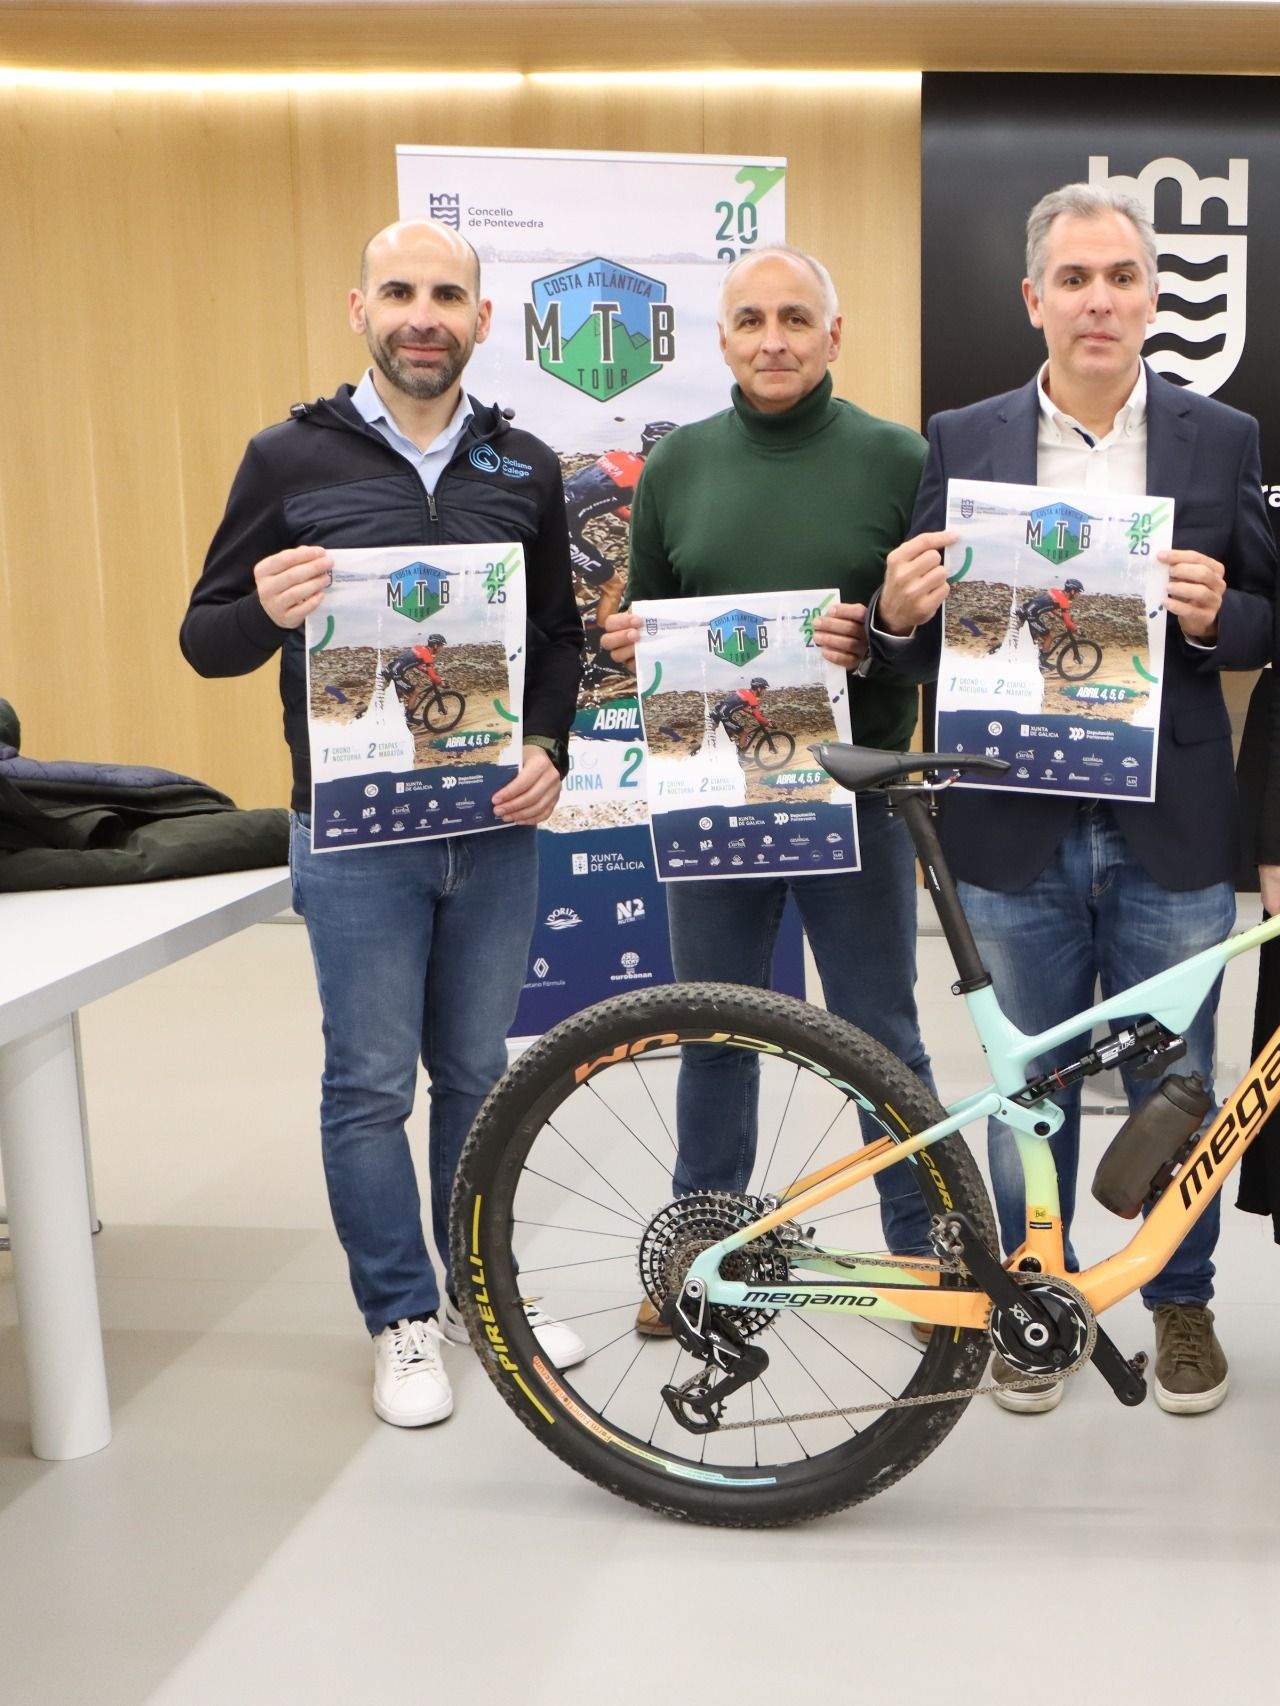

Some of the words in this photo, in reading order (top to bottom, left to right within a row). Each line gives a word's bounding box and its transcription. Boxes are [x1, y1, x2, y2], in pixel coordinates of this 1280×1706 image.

[468, 206, 513, 216] Concello
[468, 218, 481, 227] de
[484, 218, 544, 230] Pontevedra
[715, 201, 758, 244] 20
[543, 276, 582, 298] COSTA
[586, 268, 653, 298] ATLÁNTICA
[523, 303, 676, 363] MTB
[577, 368, 629, 391] TOUR
[502, 456, 532, 470] Ciclismo
[1130, 512, 1151, 533] 20
[1129, 535, 1150, 556] 25
[486, 563, 506, 582] 20
[488, 585, 506, 604] 25
[805, 629, 815, 648] 2
[994, 679, 1005, 694] 2
[1076, 687, 1099, 699] ABRIL
[1117, 690, 1125, 700] 6
[593, 708, 639, 730] ABRIL
[445, 737, 467, 748] ABRIL
[484, 733, 491, 744] 6
[367, 743, 376, 758] 2
[619, 747, 644, 787] 2
[566, 774, 603, 791] URNA
[700, 777, 709, 792] 2
[776, 774, 798, 785] ABRIL
[814, 771, 821, 782] 6
[591, 853, 623, 863] XUNTA
[591, 863, 604, 872] DE
[606, 861, 645, 871] GALICIA
[616, 898, 645, 921] N2
[742, 1291, 878, 1307] megamo
[470, 1255, 519, 1374] PIRELLI
